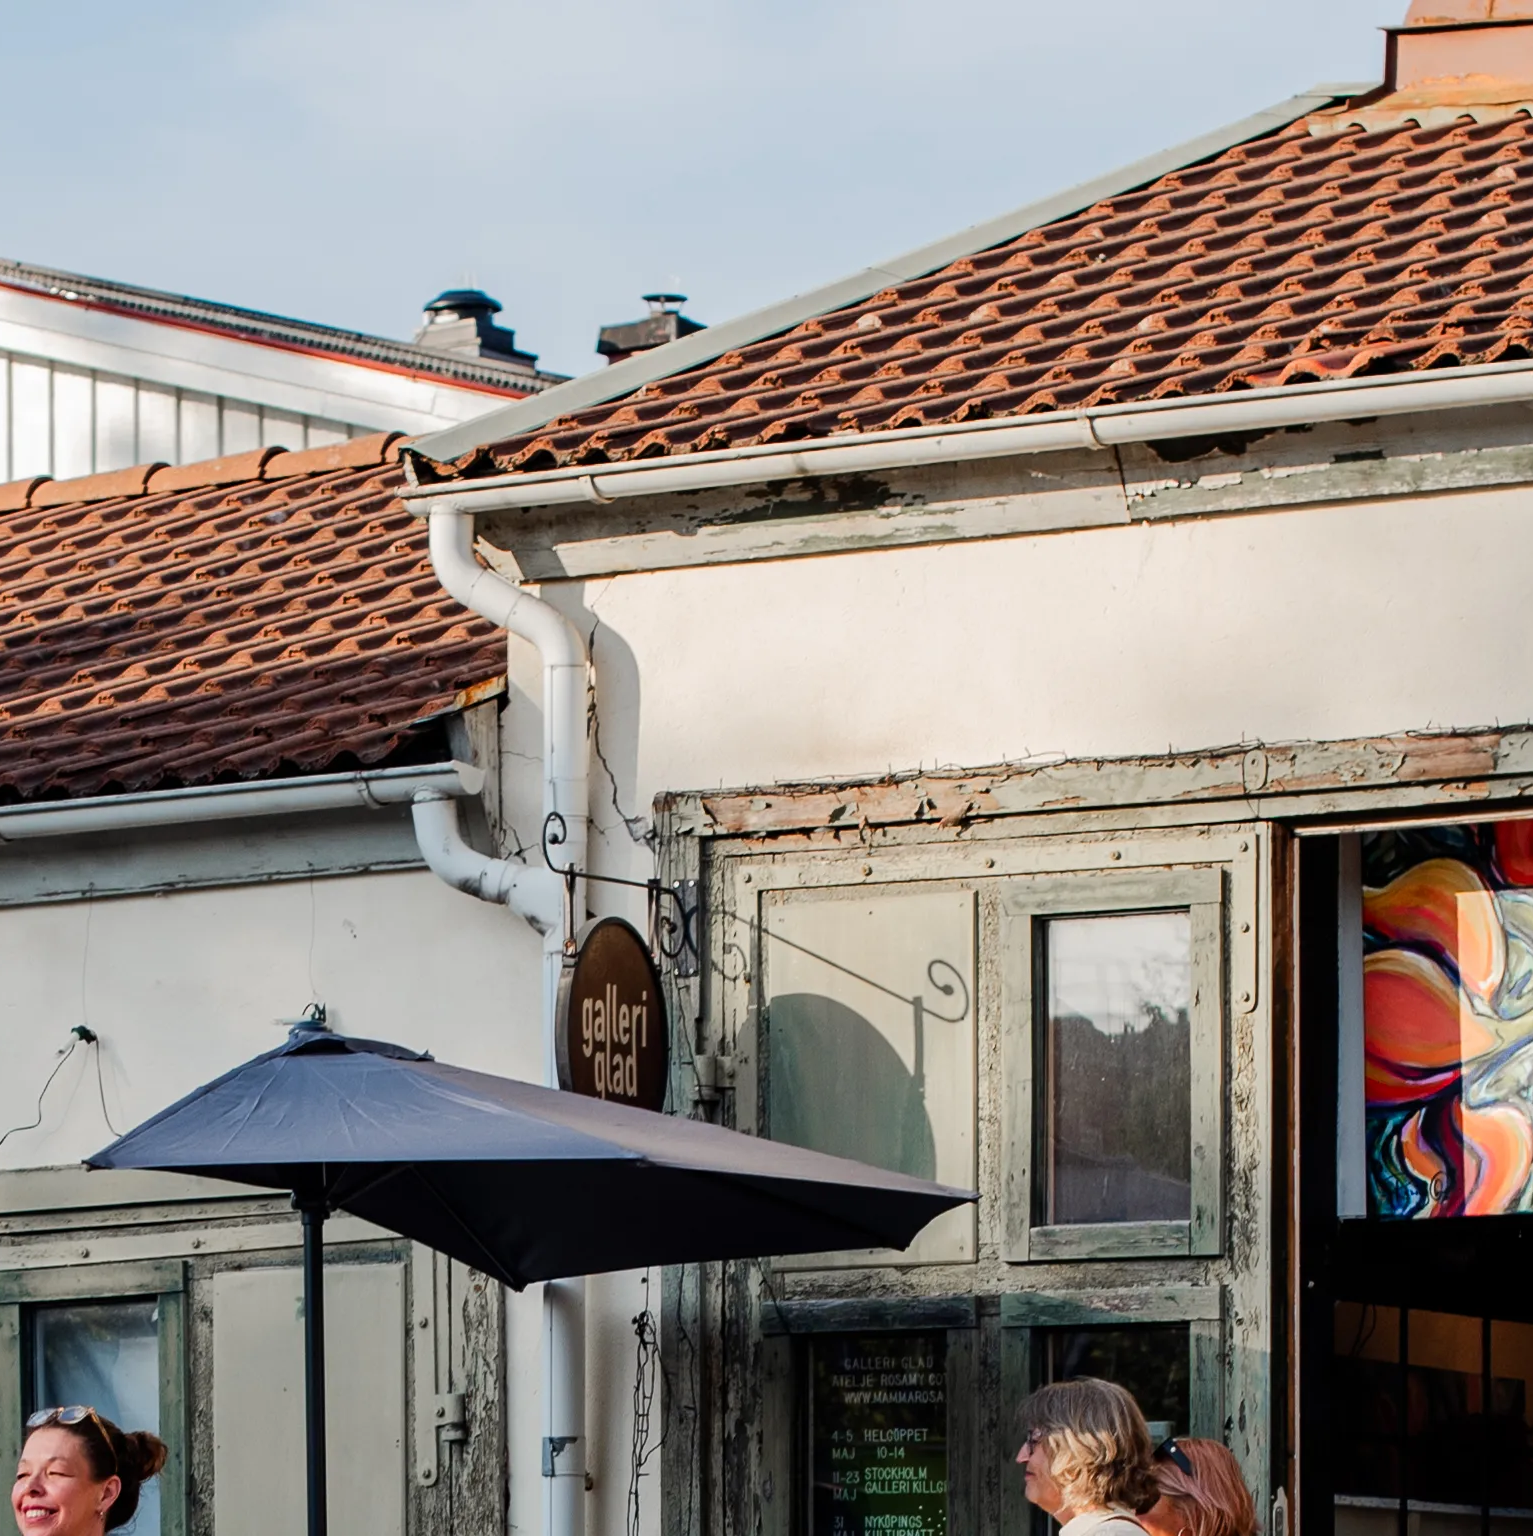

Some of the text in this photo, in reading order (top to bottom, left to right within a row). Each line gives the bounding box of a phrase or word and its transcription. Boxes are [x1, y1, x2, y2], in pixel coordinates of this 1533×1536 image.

[582, 983, 647, 1058] galleri
[844, 1356, 934, 1370] GALLERI GLAD
[830, 1428, 929, 1442] 4-5 HELGÖPPET
[832, 1446, 906, 1460] MAJ 10-14
[864, 1466, 928, 1480] STOCKHOLM
[832, 1470, 860, 1484] 11-23
[864, 1481, 910, 1494] GALLERI
[833, 1487, 857, 1501] MAJ
[864, 1514, 923, 1529] NYKÖPINGS
